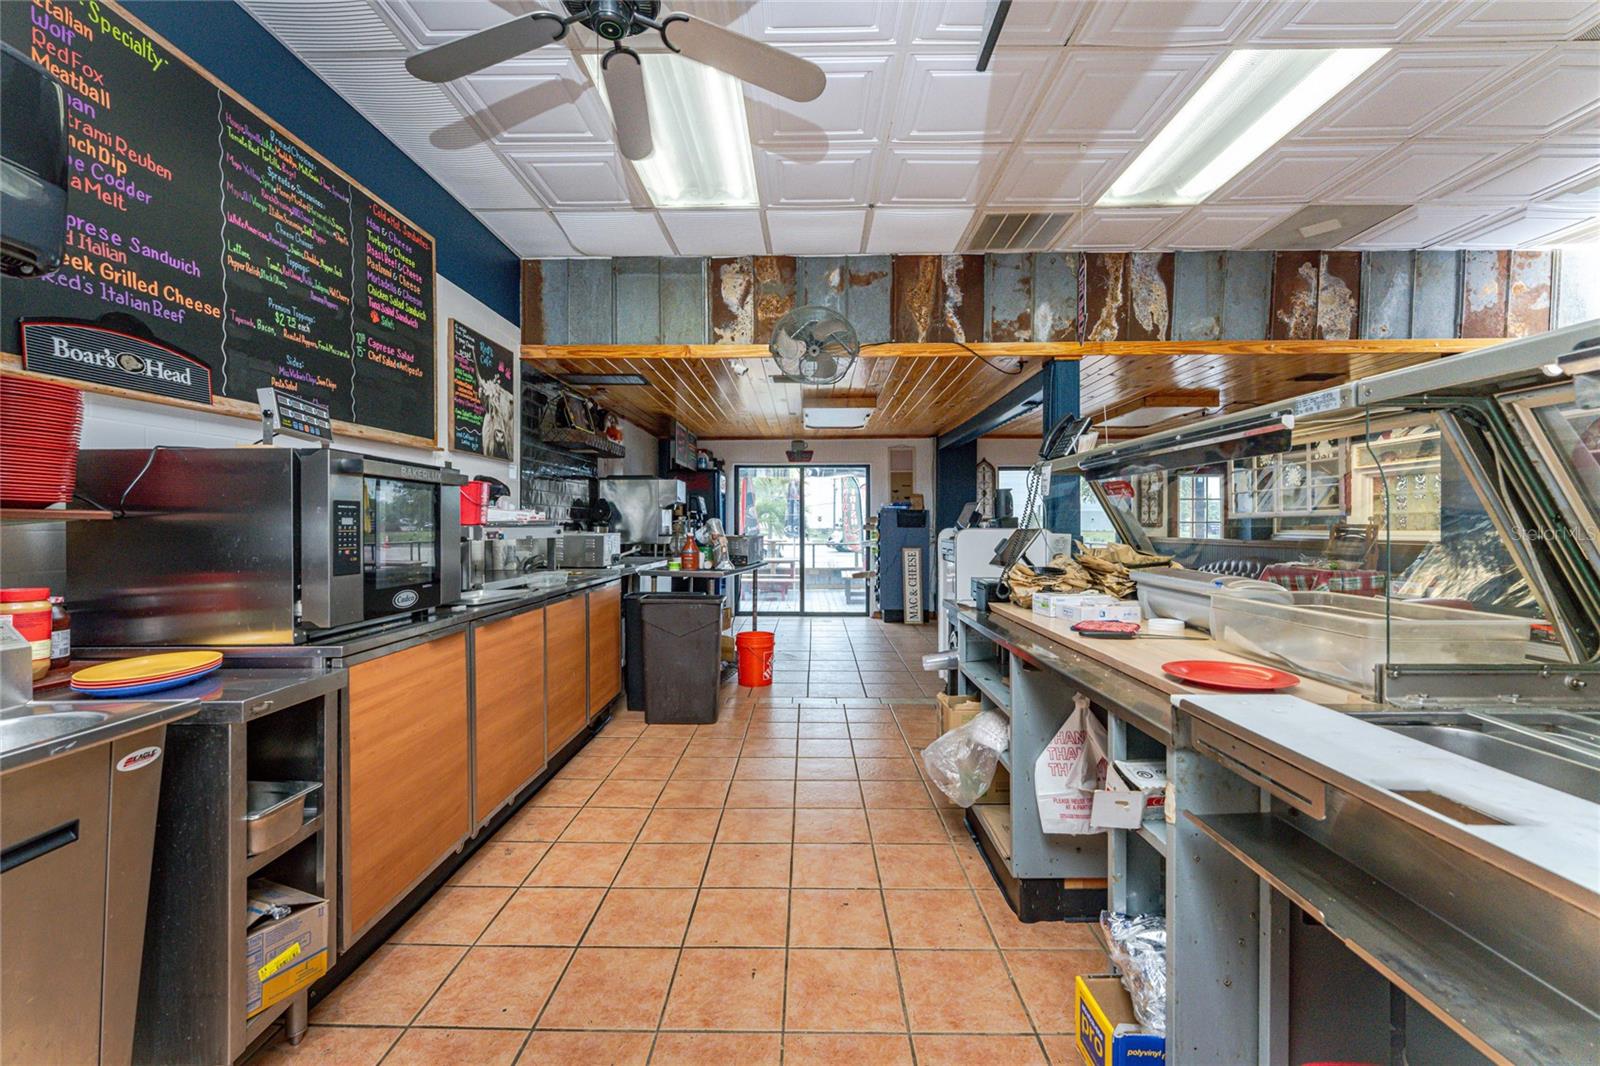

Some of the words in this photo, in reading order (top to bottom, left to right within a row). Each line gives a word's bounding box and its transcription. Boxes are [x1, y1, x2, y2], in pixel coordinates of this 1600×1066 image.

[31, 5, 75, 46] Wolf
[31, 47, 111, 109] Meatball
[99, 149, 127, 178] Dip
[115, 136, 173, 182] Reuben
[85, 177, 128, 212] Melt
[91, 163, 153, 205] Codder
[78, 231, 128, 265] Italian
[366, 216, 380, 233] Ham
[381, 227, 387, 237] &
[388, 230, 412, 253] Cheese
[367, 229, 388, 252] Turkey
[388, 244, 393, 254] &
[393, 246, 415, 268] Cheese
[129, 237, 201, 278] Sandwich
[366, 243, 383, 262] Roast
[384, 254, 397, 270] Beef
[402, 265, 422, 284] Cheese
[366, 256, 392, 279] Pastrami
[399, 273, 421, 295] Cheese
[99, 282, 151, 315] Italian
[153, 300, 186, 325] Beef
[100, 263, 159, 297] Grilled
[163, 286, 222, 319] Cheese
[367, 283, 388, 302] Chicken
[389, 295, 404, 310] Salad
[405, 302, 426, 321] Sandwich
[402, 289, 422, 308] Cheese
[368, 296, 380, 311] Tuna
[380, 302, 394, 318] Salad
[395, 311, 418, 328] Sandwich
[51, 336, 117, 369] Boar's
[139, 358, 192, 386] Head
[367, 336, 394, 356] Caprese
[397, 348, 414, 363] Salad
[368, 350, 382, 362] Chef
[382, 355, 396, 367] Salad
[401, 466, 442, 482] BAKERLUX
[907, 551, 918, 588] CHEESE
[908, 597, 919, 620] MAC
[909, 589, 919, 597] &
